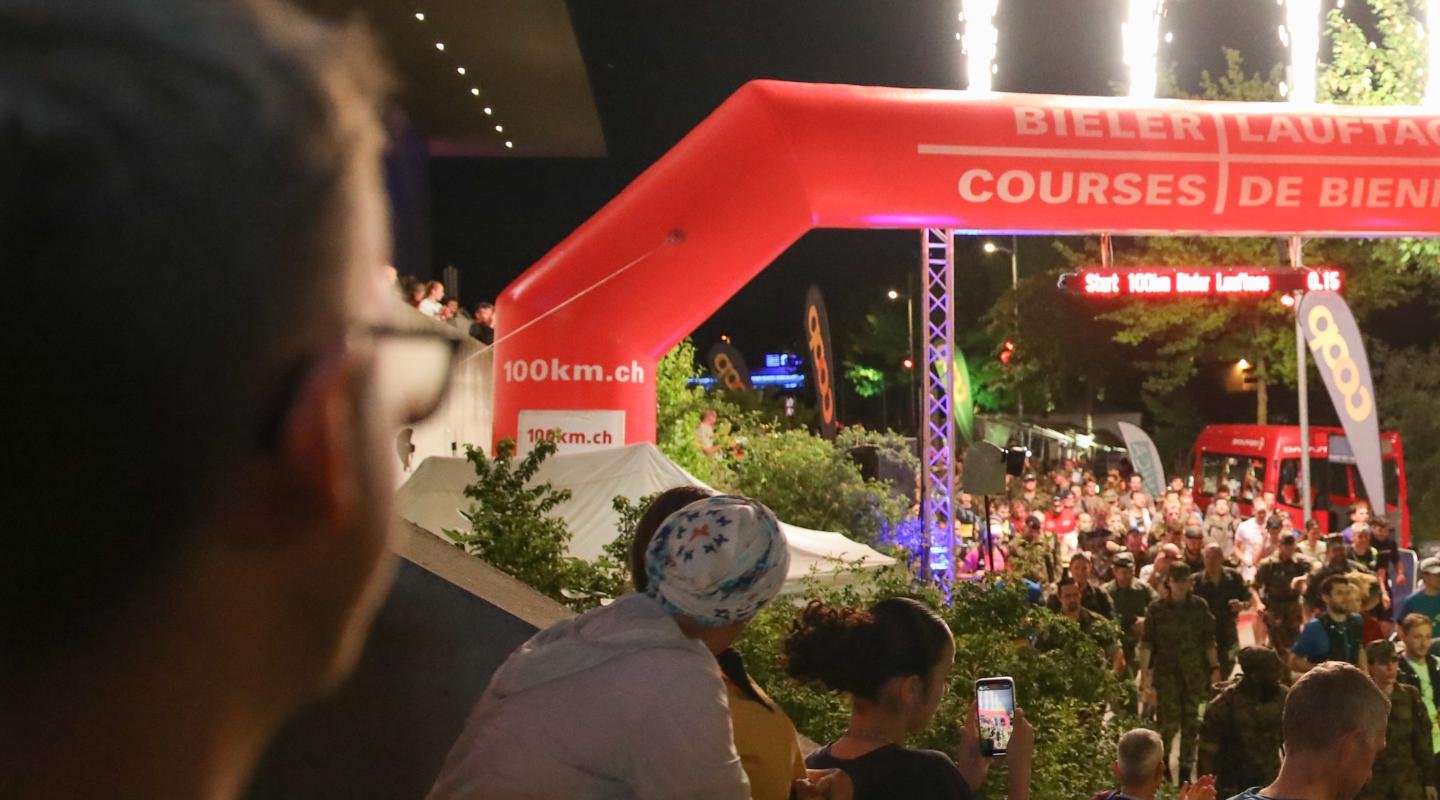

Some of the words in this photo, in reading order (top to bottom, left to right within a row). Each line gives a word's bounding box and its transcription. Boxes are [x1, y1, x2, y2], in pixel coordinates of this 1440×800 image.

[1013, 106, 1206, 141] BIELER
[957, 168, 1207, 206] COURSES
[1238, 175, 1304, 207] DE
[503, 358, 645, 384] 100km.ch
[1308, 304, 1372, 422] coop
[527, 428, 613, 445] 100km.ch
